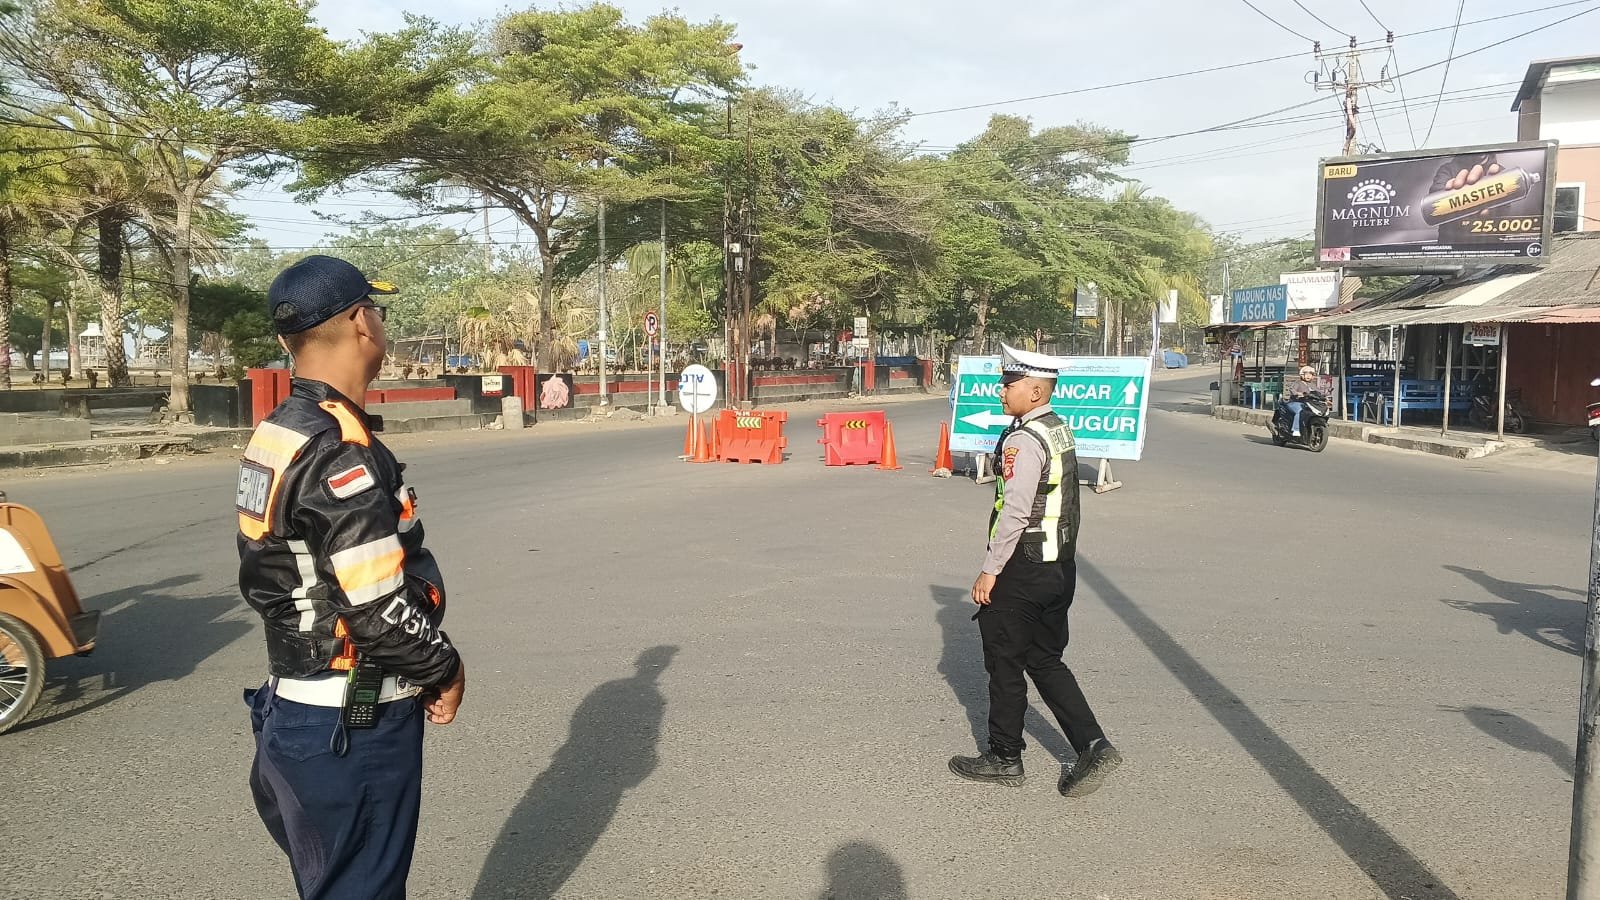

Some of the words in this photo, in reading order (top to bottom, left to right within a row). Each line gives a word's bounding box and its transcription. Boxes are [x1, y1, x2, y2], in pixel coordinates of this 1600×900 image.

[1328, 167, 1352, 176] BARU
[1356, 189, 1386, 202] 234
[1448, 182, 1505, 209] MASTER
[1331, 205, 1411, 221] MAGNUM
[1351, 218, 1390, 228] FILTER
[1234, 289, 1266, 304] WARUNG
[1266, 287, 1284, 301] NASI
[1241, 303, 1275, 321] ASGAR
